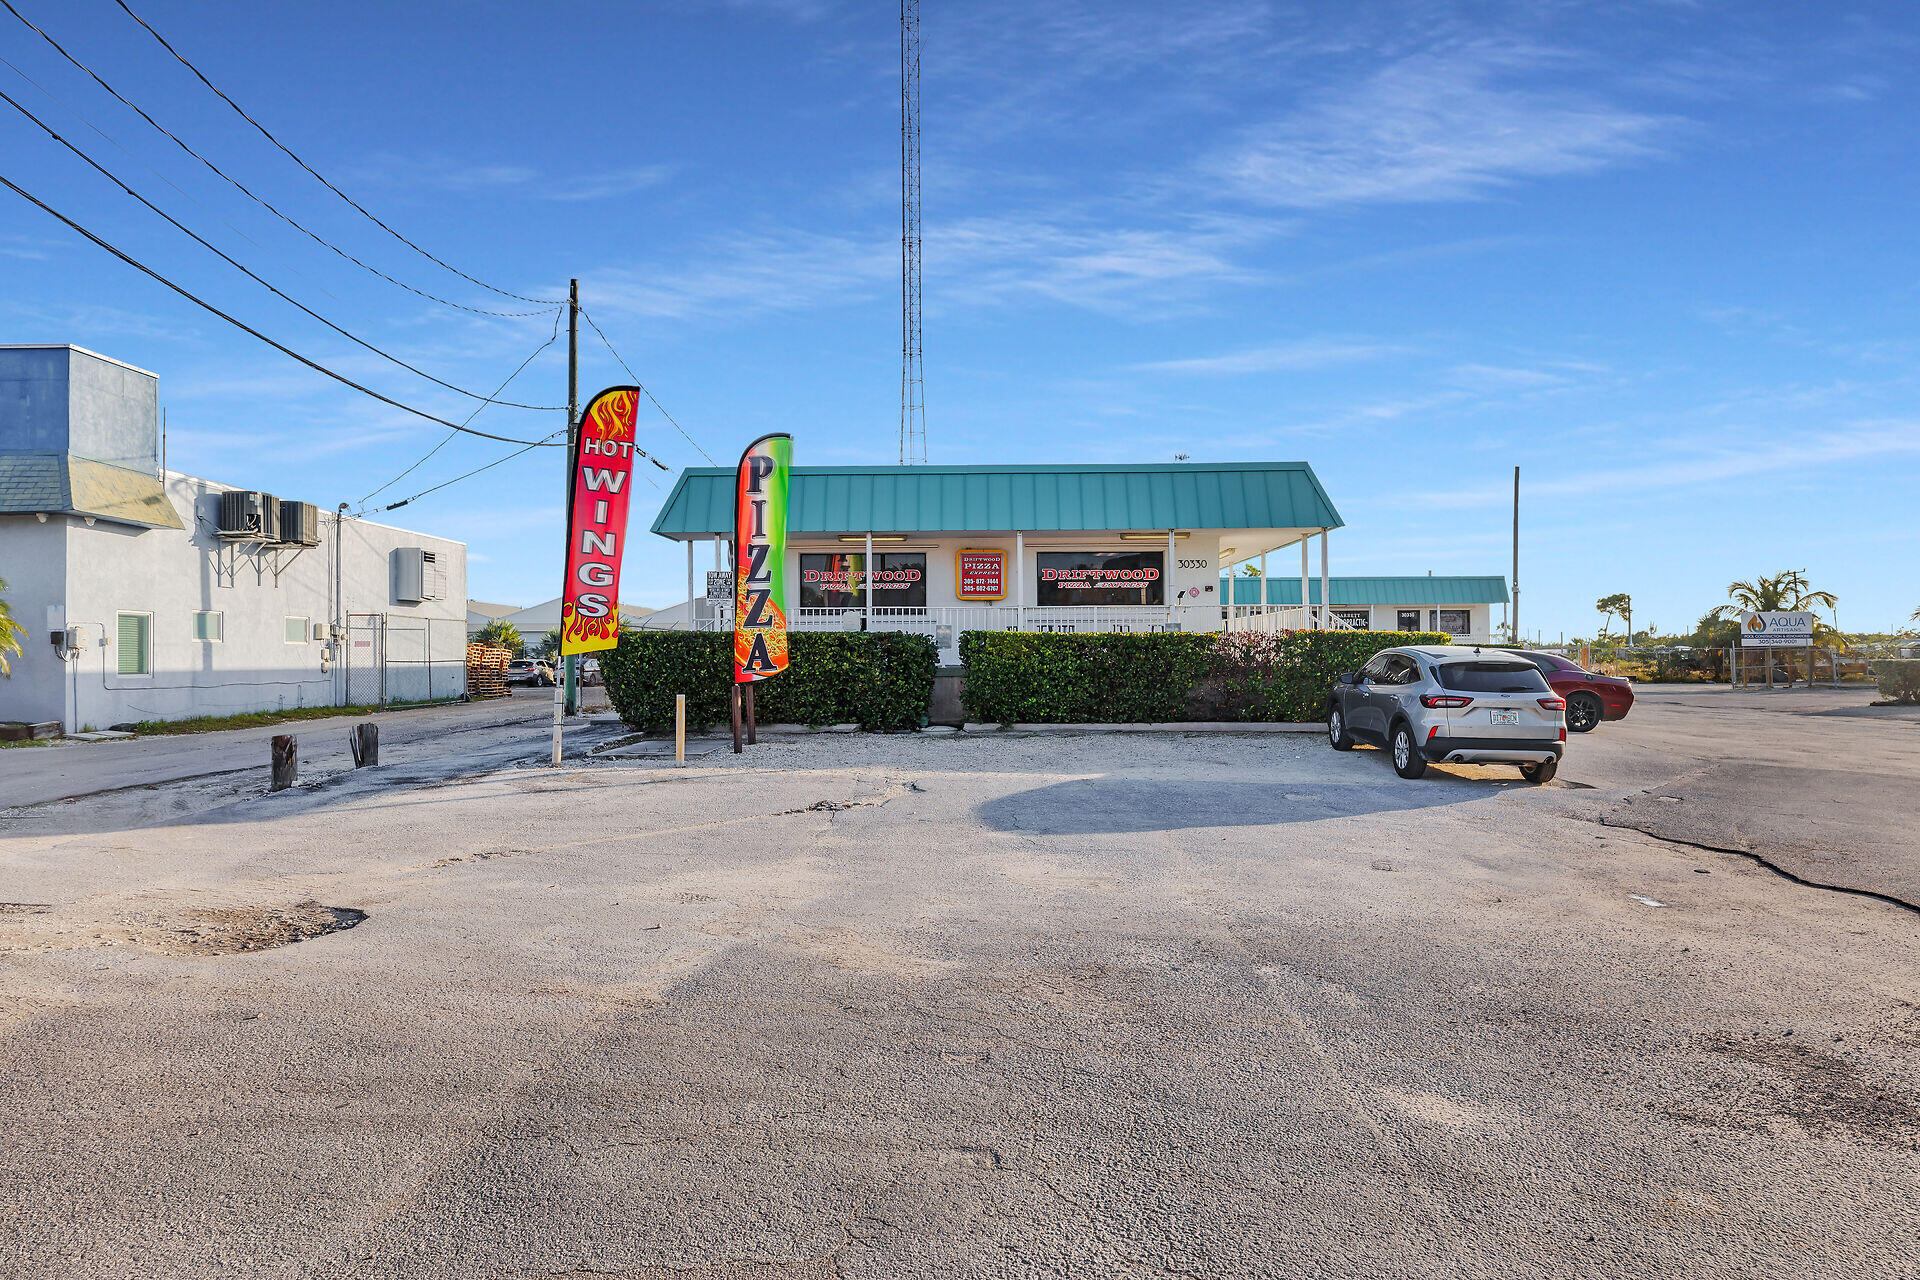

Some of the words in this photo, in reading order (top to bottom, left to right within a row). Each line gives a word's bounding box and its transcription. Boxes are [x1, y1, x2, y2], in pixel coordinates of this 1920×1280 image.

[584, 437, 634, 459] HOT
[577, 466, 627, 618] WINGS
[741, 455, 778, 674] PIZZA
[1178, 559, 1208, 569] 30330
[1042, 568, 1159, 580] DRIFTWOOD
[1769, 617, 1806, 626] AQUA
